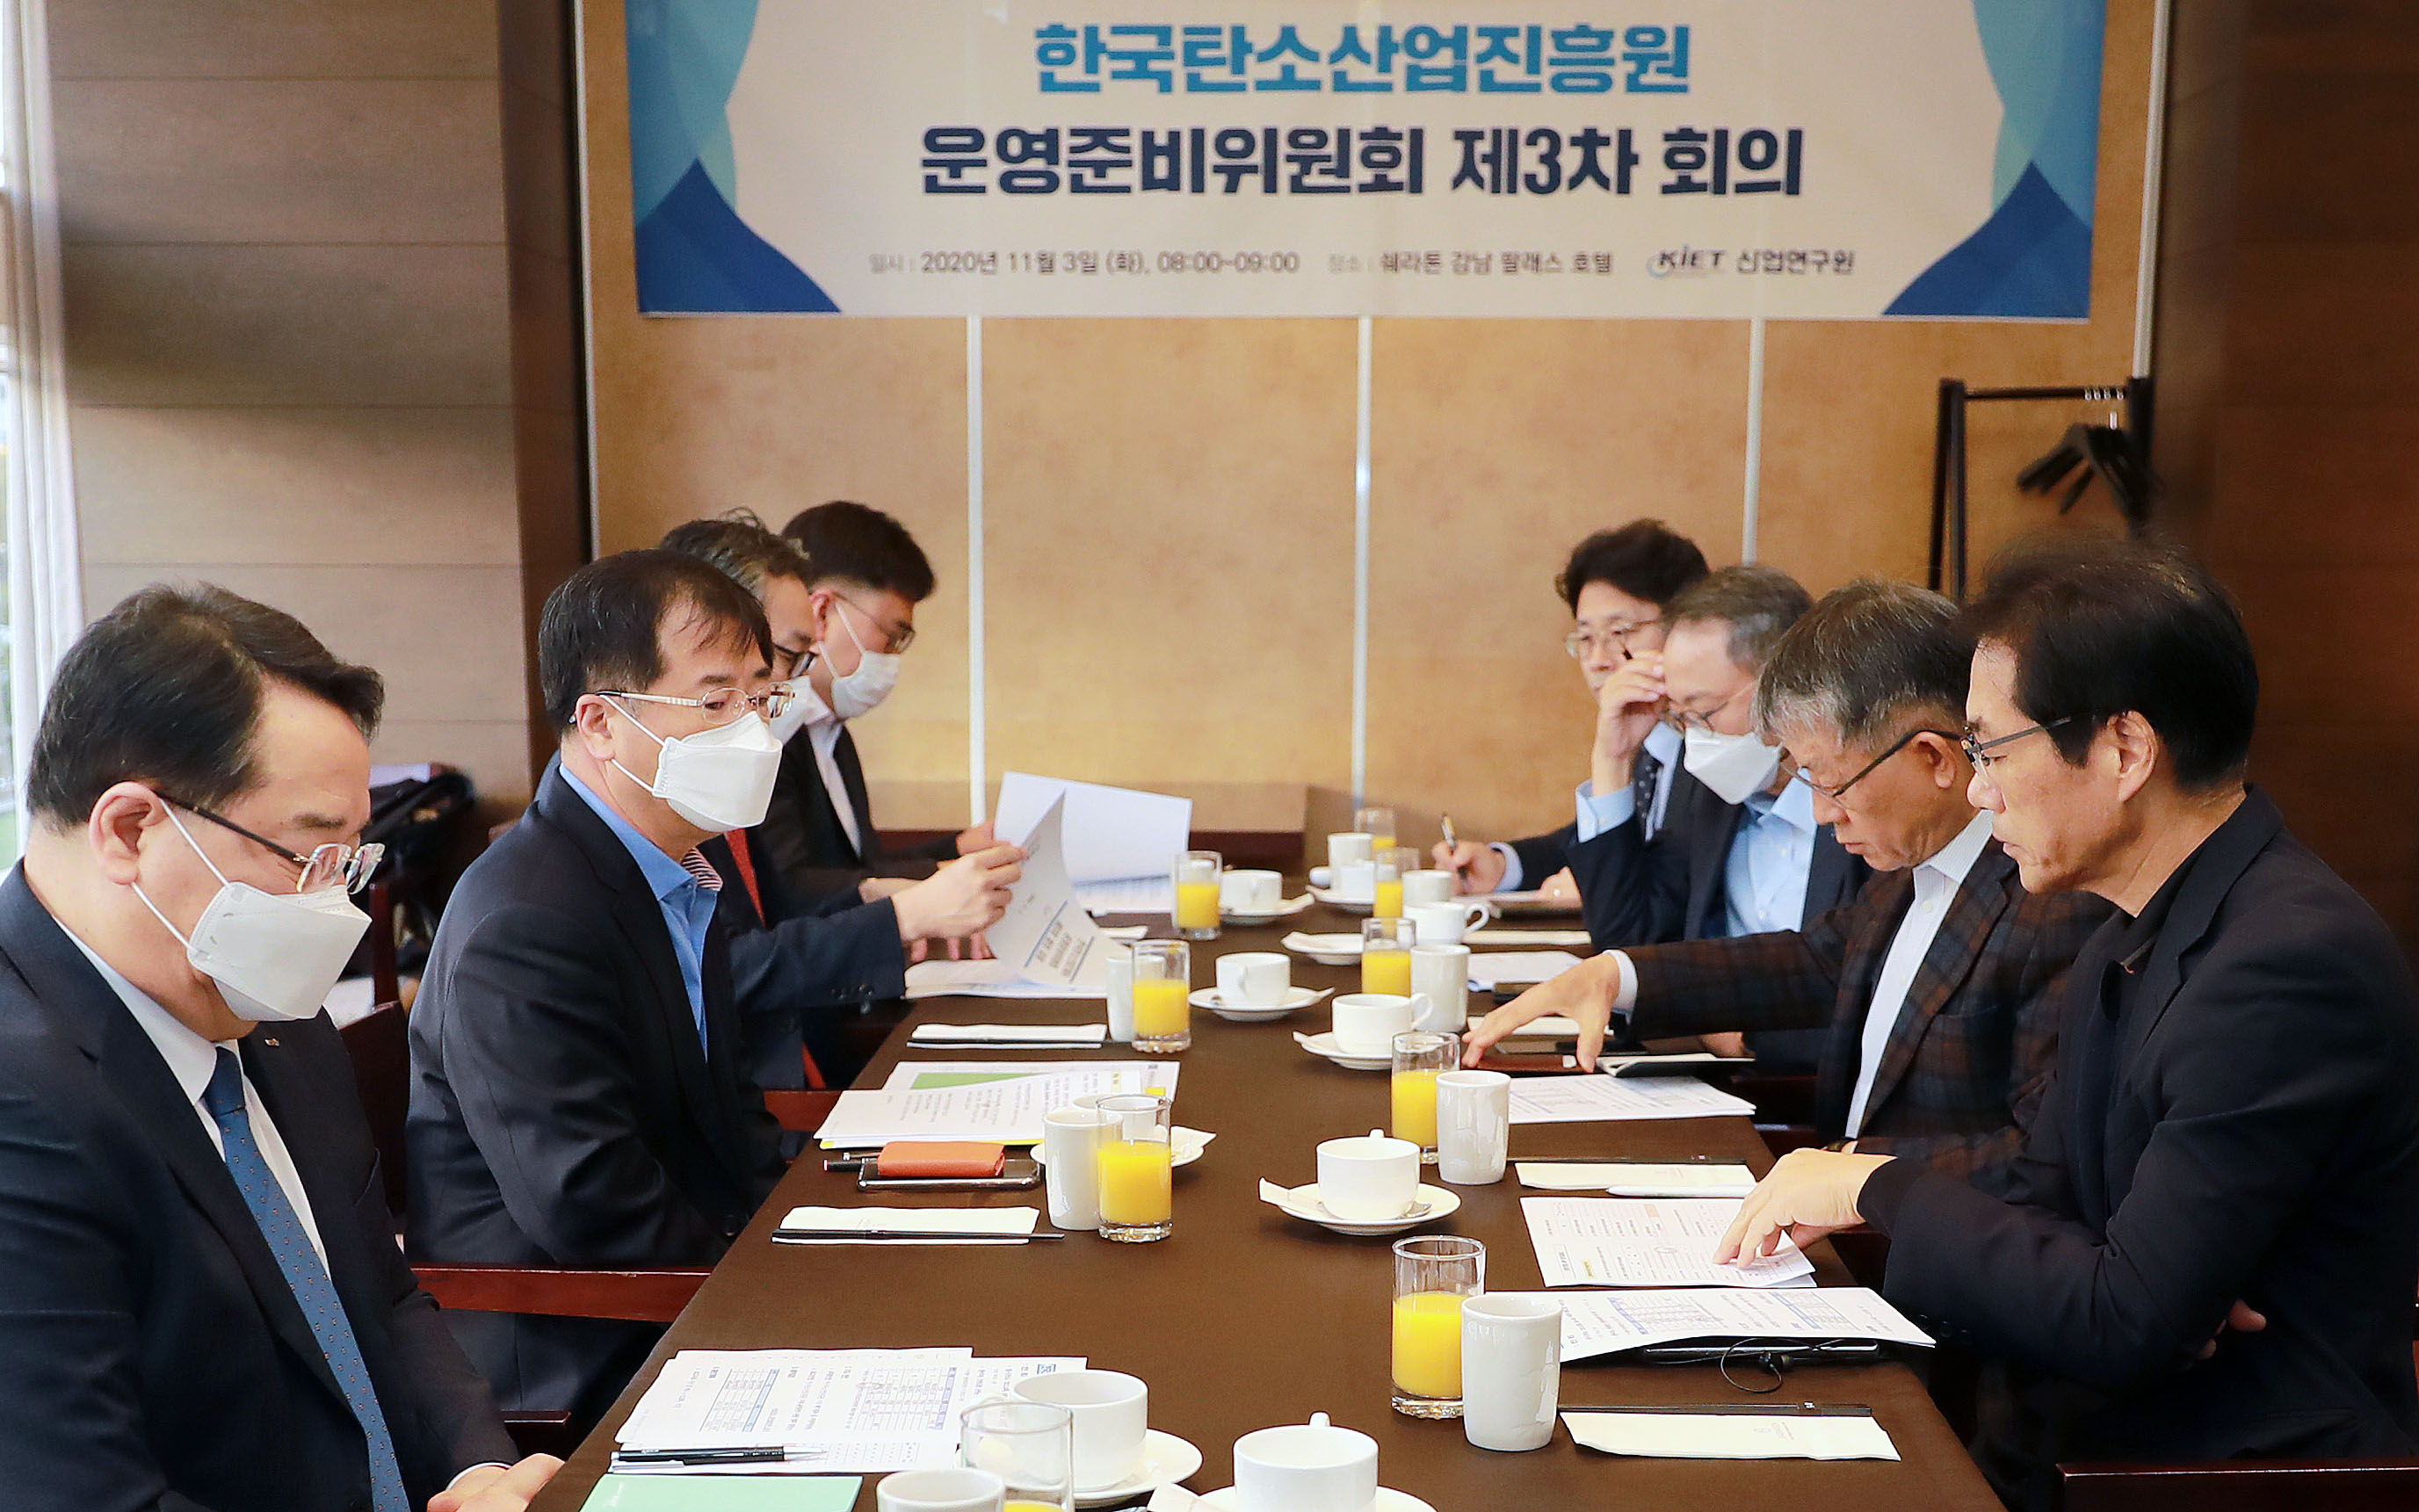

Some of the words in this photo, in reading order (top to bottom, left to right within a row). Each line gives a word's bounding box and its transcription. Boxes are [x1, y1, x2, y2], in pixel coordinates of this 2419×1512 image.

[1035, 23, 1691, 94] 한국탄소산업진흥원
[920, 126, 1424, 197] 운영준비위원회
[1451, 126, 1640, 197] 제3차
[1660, 126, 1804, 198] 회의
[920, 250, 999, 276] 2020년
[1009, 250, 1057, 277] 11월
[1062, 250, 1100, 276] 3일
[1105, 250, 1151, 277] (화),
[1379, 250, 1443, 276] 쉐라톤
[1451, 251, 1494, 276] 강남
[1569, 250, 1614, 277] 호텔
[1735, 250, 1855, 276] 산업연구원
